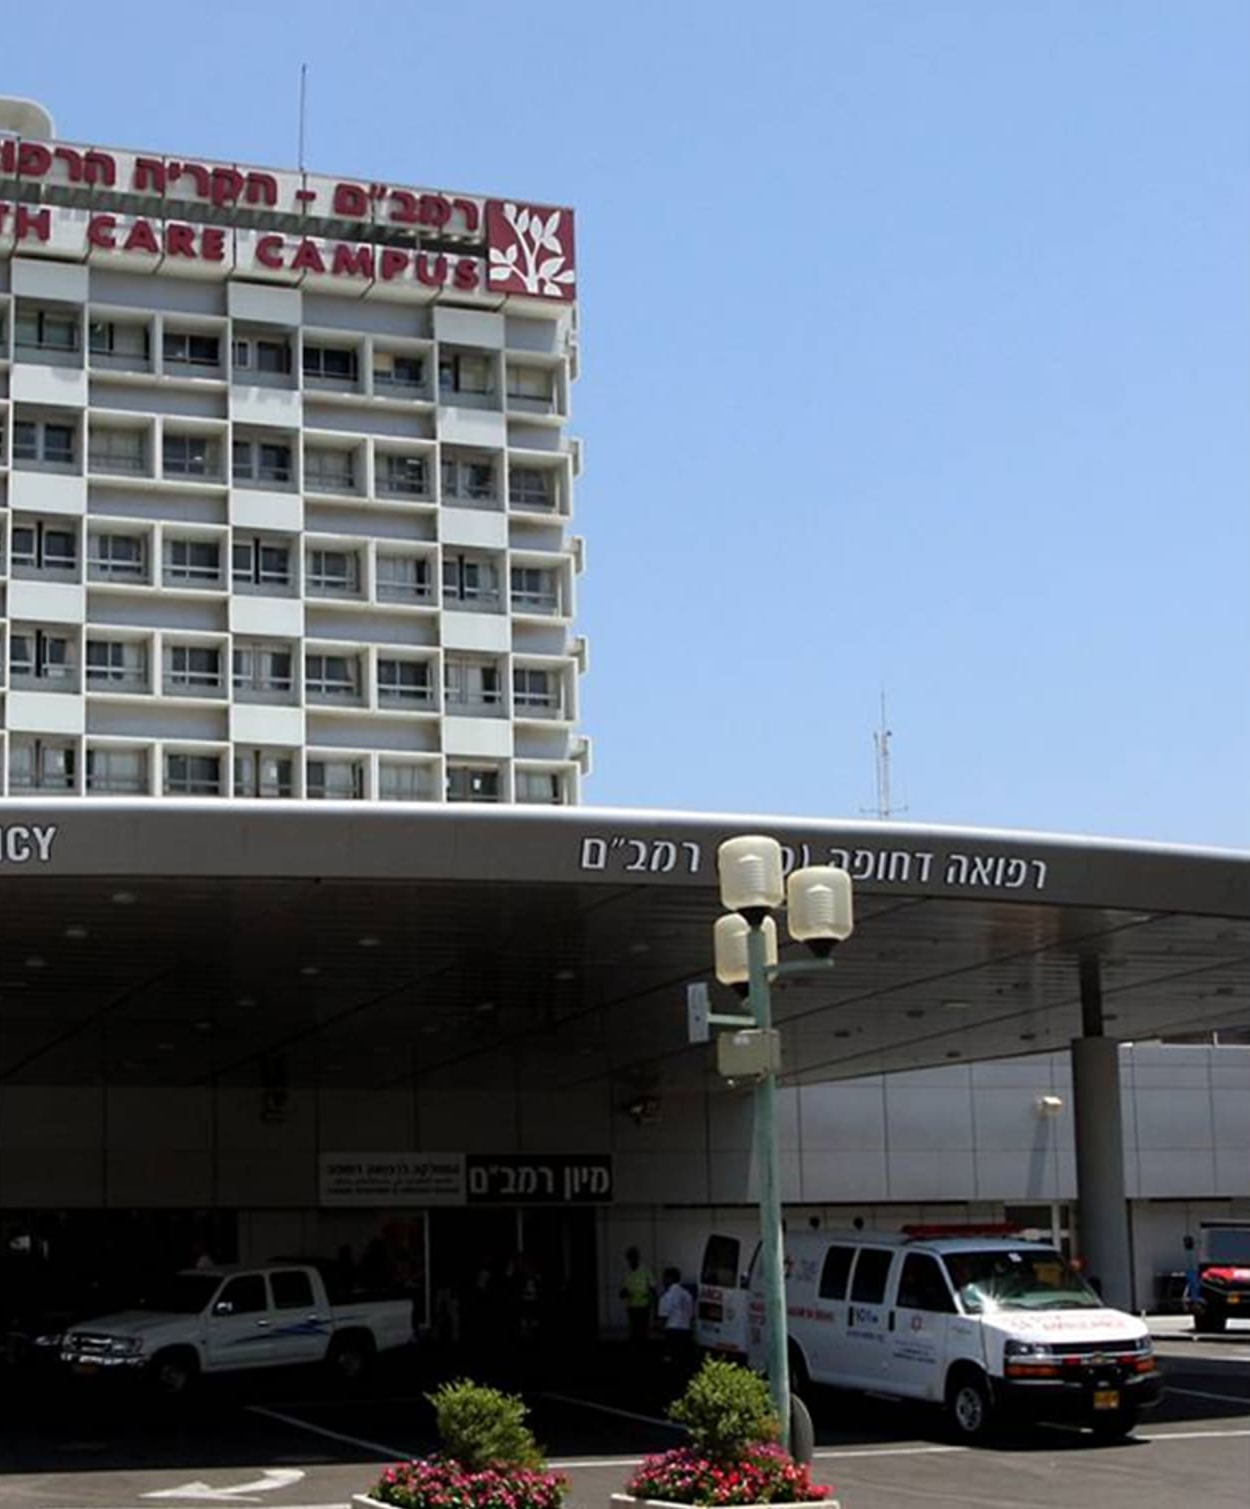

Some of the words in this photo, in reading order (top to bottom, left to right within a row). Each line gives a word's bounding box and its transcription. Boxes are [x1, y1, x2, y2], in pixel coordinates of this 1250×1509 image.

[134, 157, 278, 208] הקריה
[334, 183, 479, 231] רמב"ם
[87, 215, 227, 262] CARE
[255, 236, 481, 291] CAMPUS
[581, 837, 700, 872] רמב"ם
[947, 854, 1047, 889] רפואה
[470, 1166, 554, 1194] רמב"ם
[565, 1166, 610, 1200] מיון
